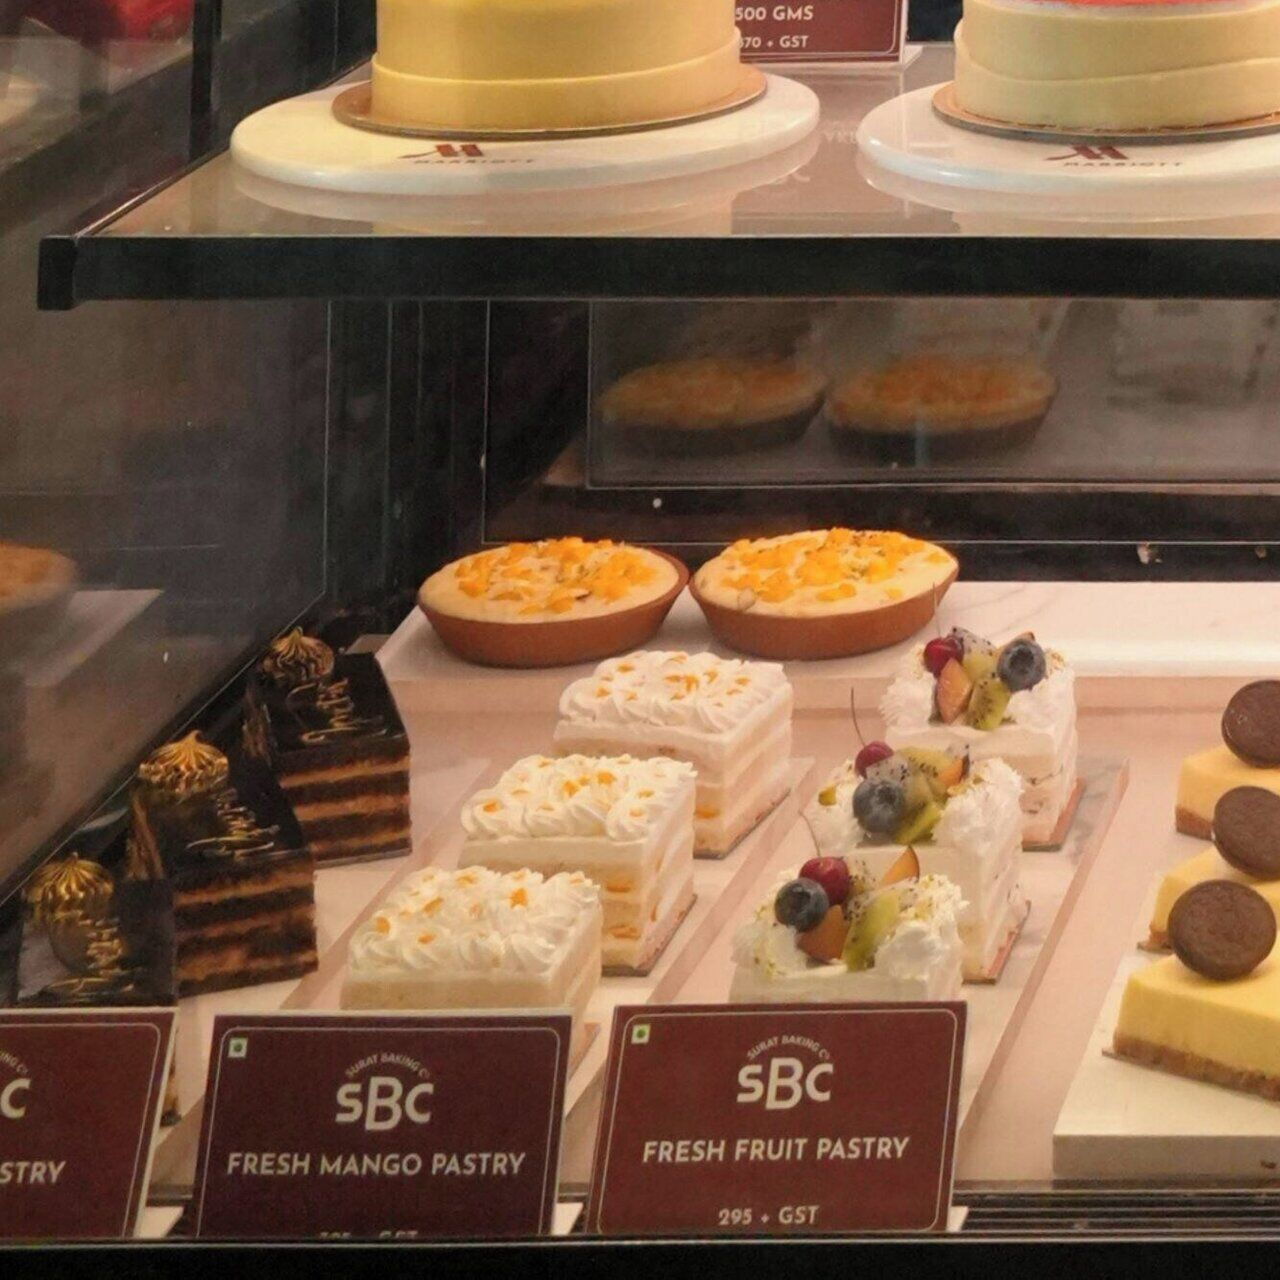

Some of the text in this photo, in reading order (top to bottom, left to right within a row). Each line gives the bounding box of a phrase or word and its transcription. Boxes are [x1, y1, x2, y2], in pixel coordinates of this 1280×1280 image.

[735, 5, 814, 21] 500 GMS
[779, 35, 809, 48] GST
[782, 1034, 820, 1052] BAKING
[381, 1052, 422, 1073] BAKING
[737, 1057, 834, 1110] SBC
[335, 1076, 434, 1131] SBC
[643, 1137, 910, 1163] FRESH FRUIT PASTRY
[0, 1160, 66, 1184] STRY
[227, 1152, 526, 1176] FRESH MANGO PASTRY
[719, 1208, 752, 1225] 295
[779, 1206, 819, 1224] GST
